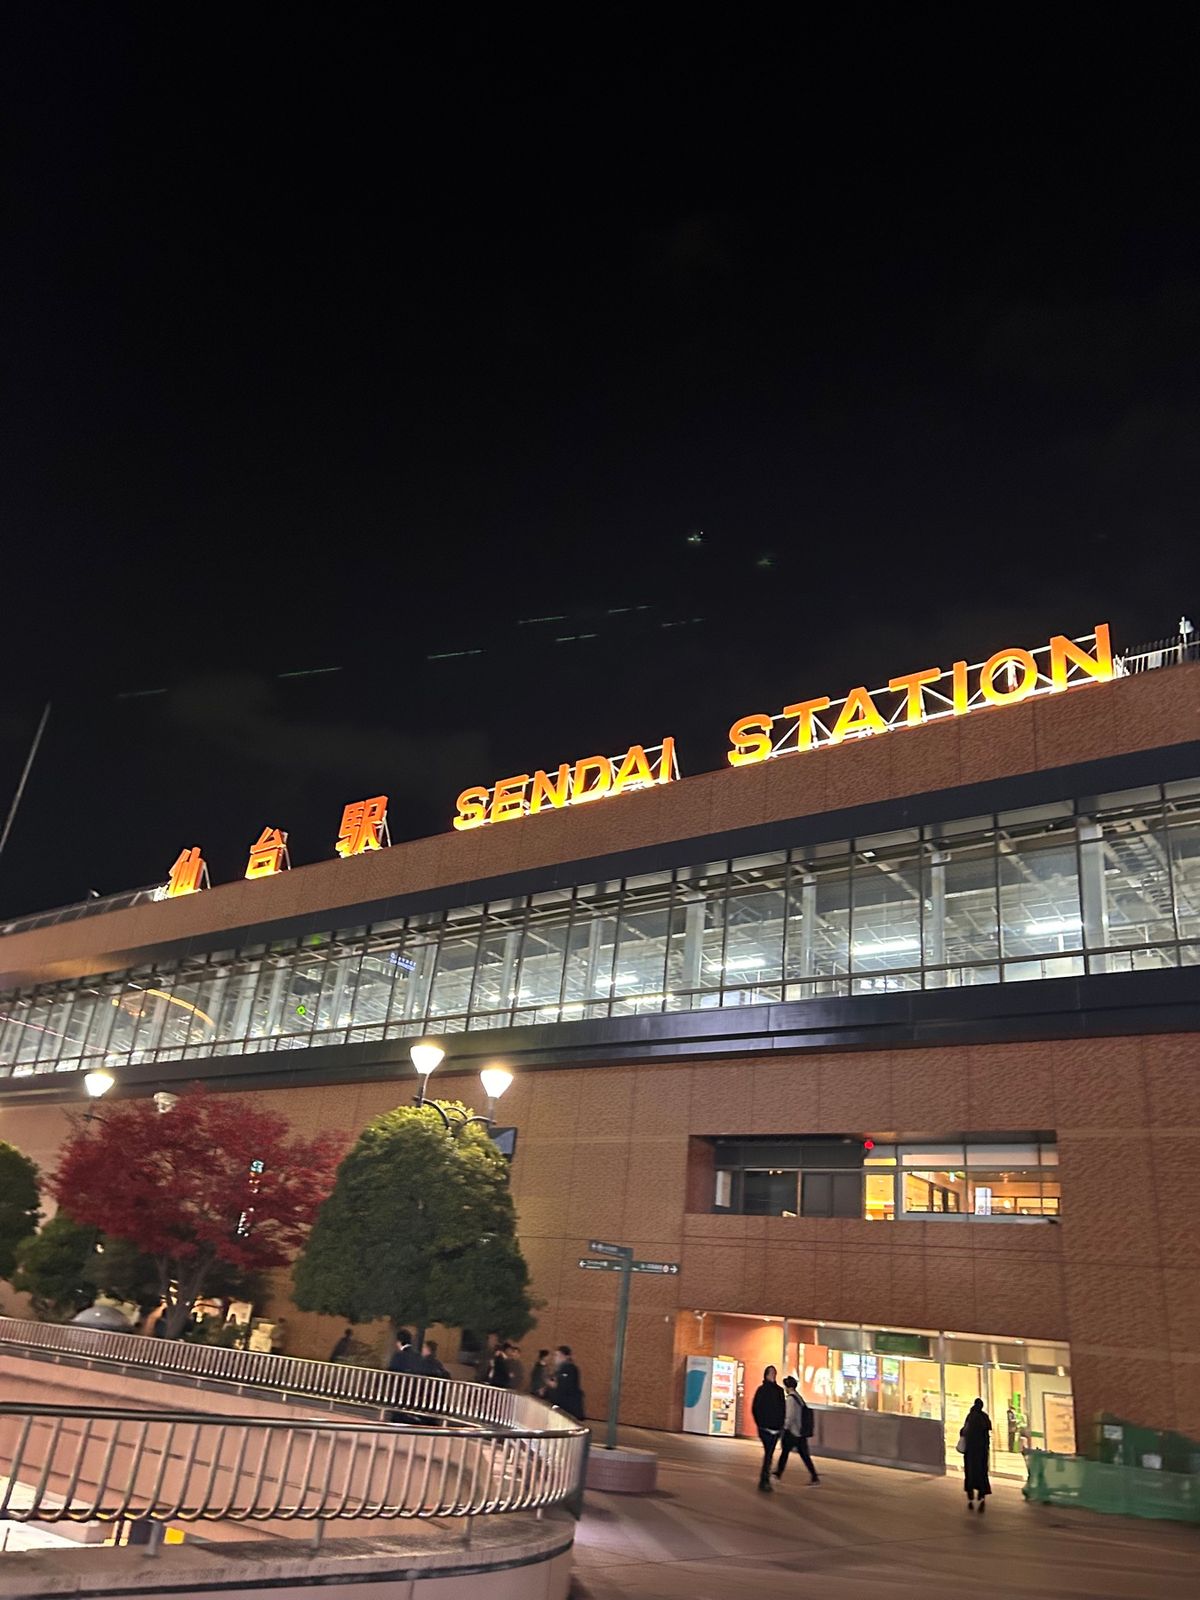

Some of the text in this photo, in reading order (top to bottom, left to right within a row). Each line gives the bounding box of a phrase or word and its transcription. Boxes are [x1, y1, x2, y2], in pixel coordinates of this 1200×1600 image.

[453, 623, 1113, 831] SENDAI STATION
[167, 795, 388, 899] 仙台駅
